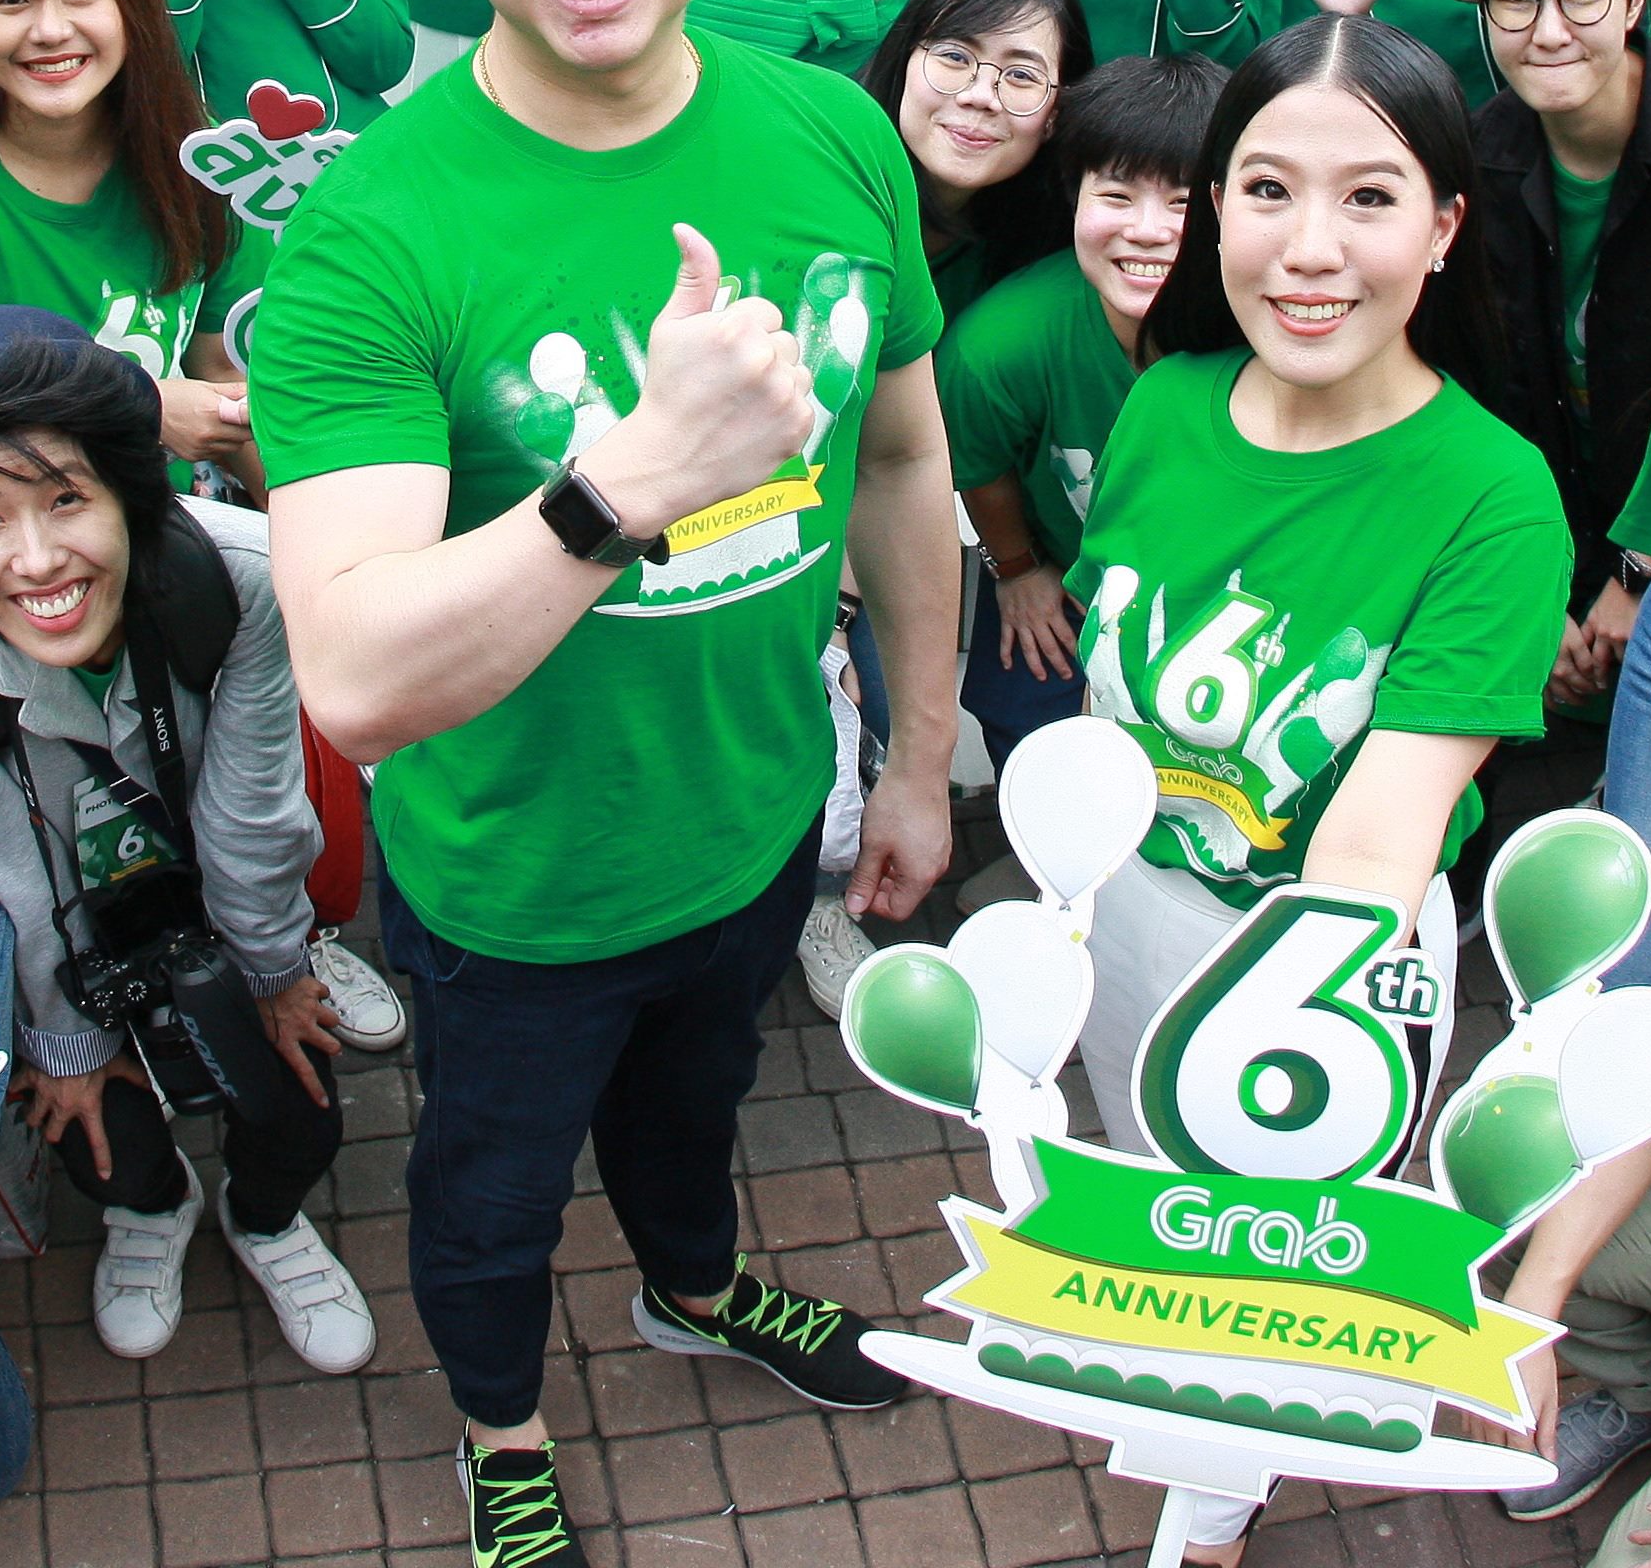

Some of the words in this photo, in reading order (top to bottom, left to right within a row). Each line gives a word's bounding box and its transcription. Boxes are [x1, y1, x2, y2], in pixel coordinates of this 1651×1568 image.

[663, 490, 787, 544] ANNIVERSARY
[1155, 595, 1287, 750] 6th
[152, 706, 171, 752] SONY
[1165, 737, 1244, 785] Grab
[85, 797, 114, 815] PHOT
[1156, 770, 1252, 825] ANNIVERSARY
[1175, 906, 1438, 1180] 6th
[1149, 1184, 1368, 1276] Grab
[1053, 1270, 1436, 1366] ANNIVERSARY
